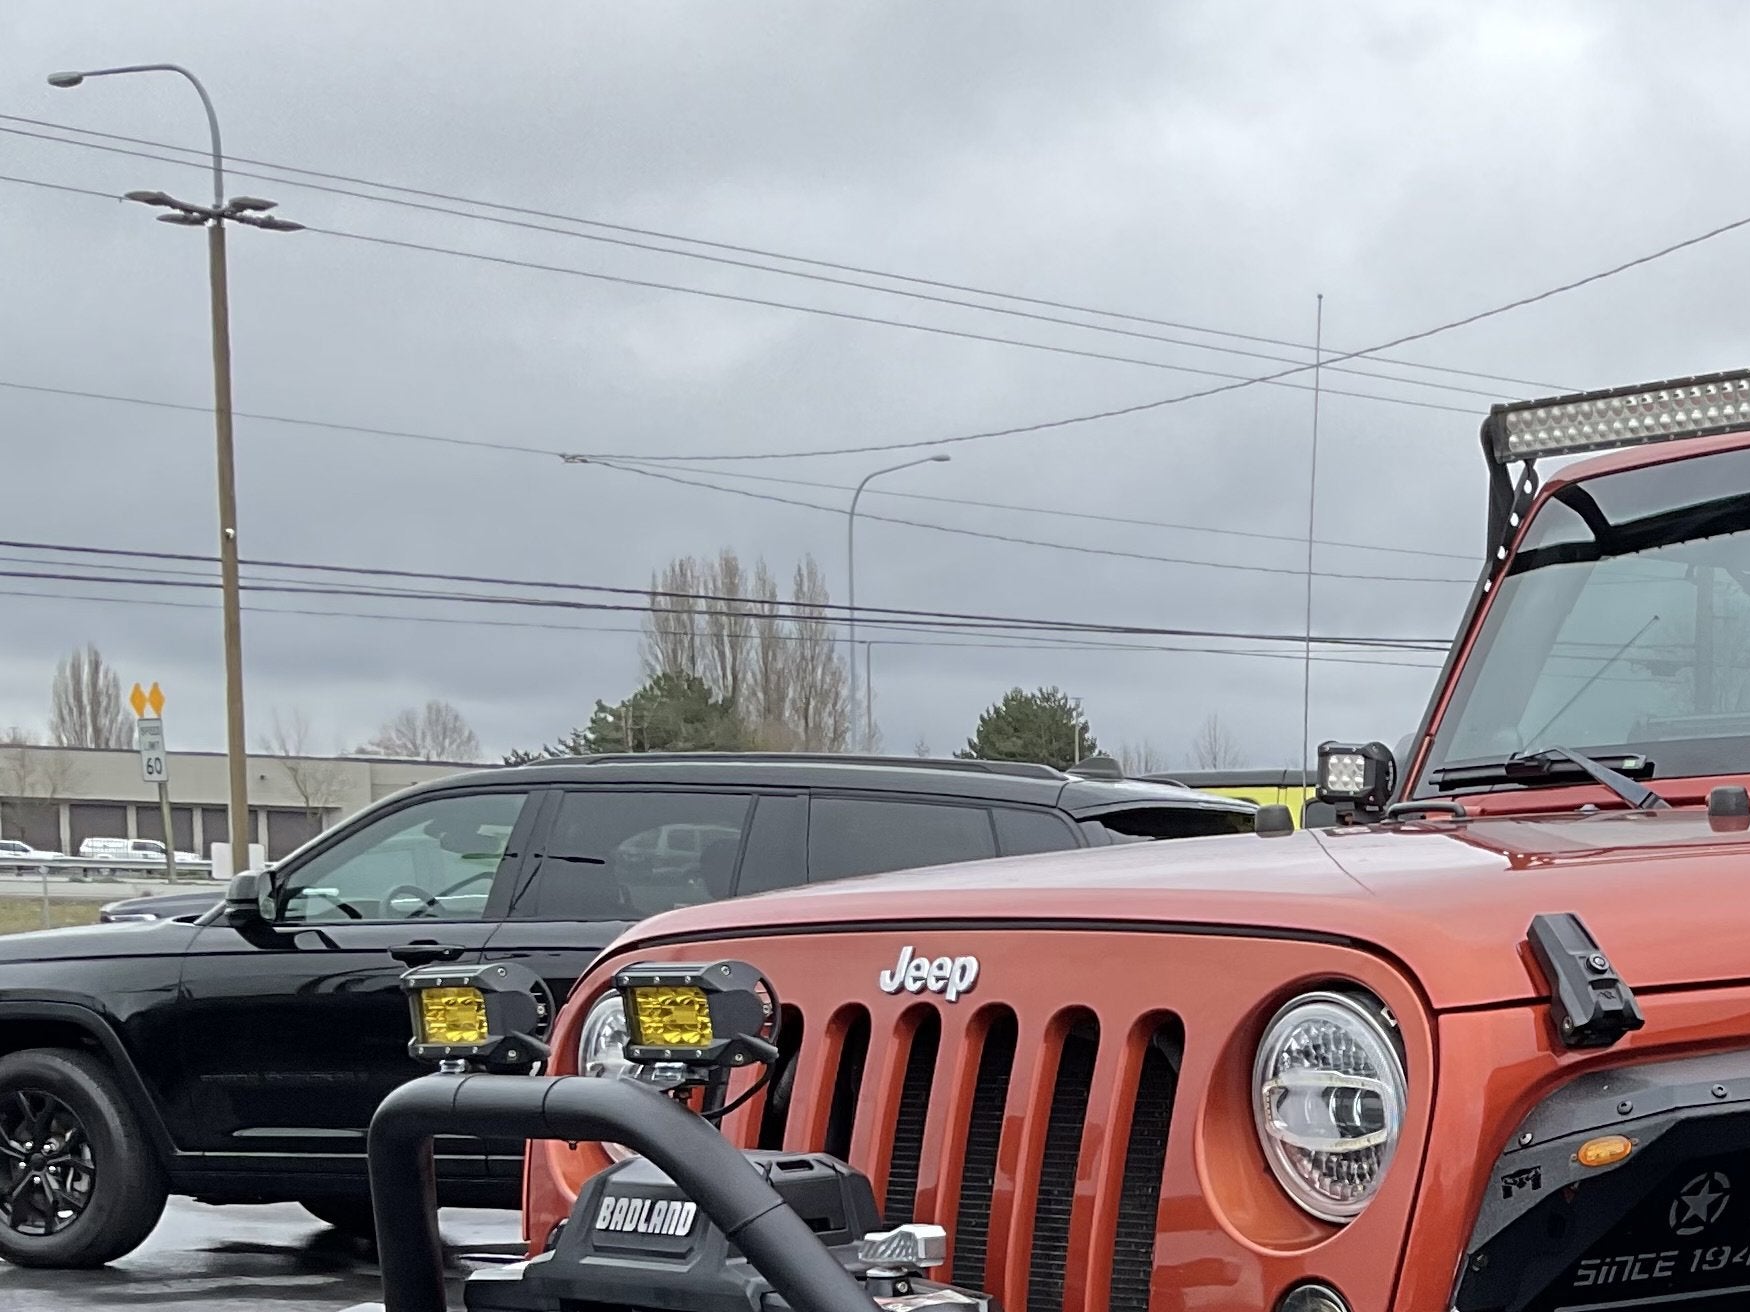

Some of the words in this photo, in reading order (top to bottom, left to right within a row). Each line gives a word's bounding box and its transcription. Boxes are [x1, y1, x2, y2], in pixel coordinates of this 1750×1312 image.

[146, 757, 163, 775] 60
[879, 945, 981, 1003] Jeep
[595, 1196, 697, 1237] BADLAND
